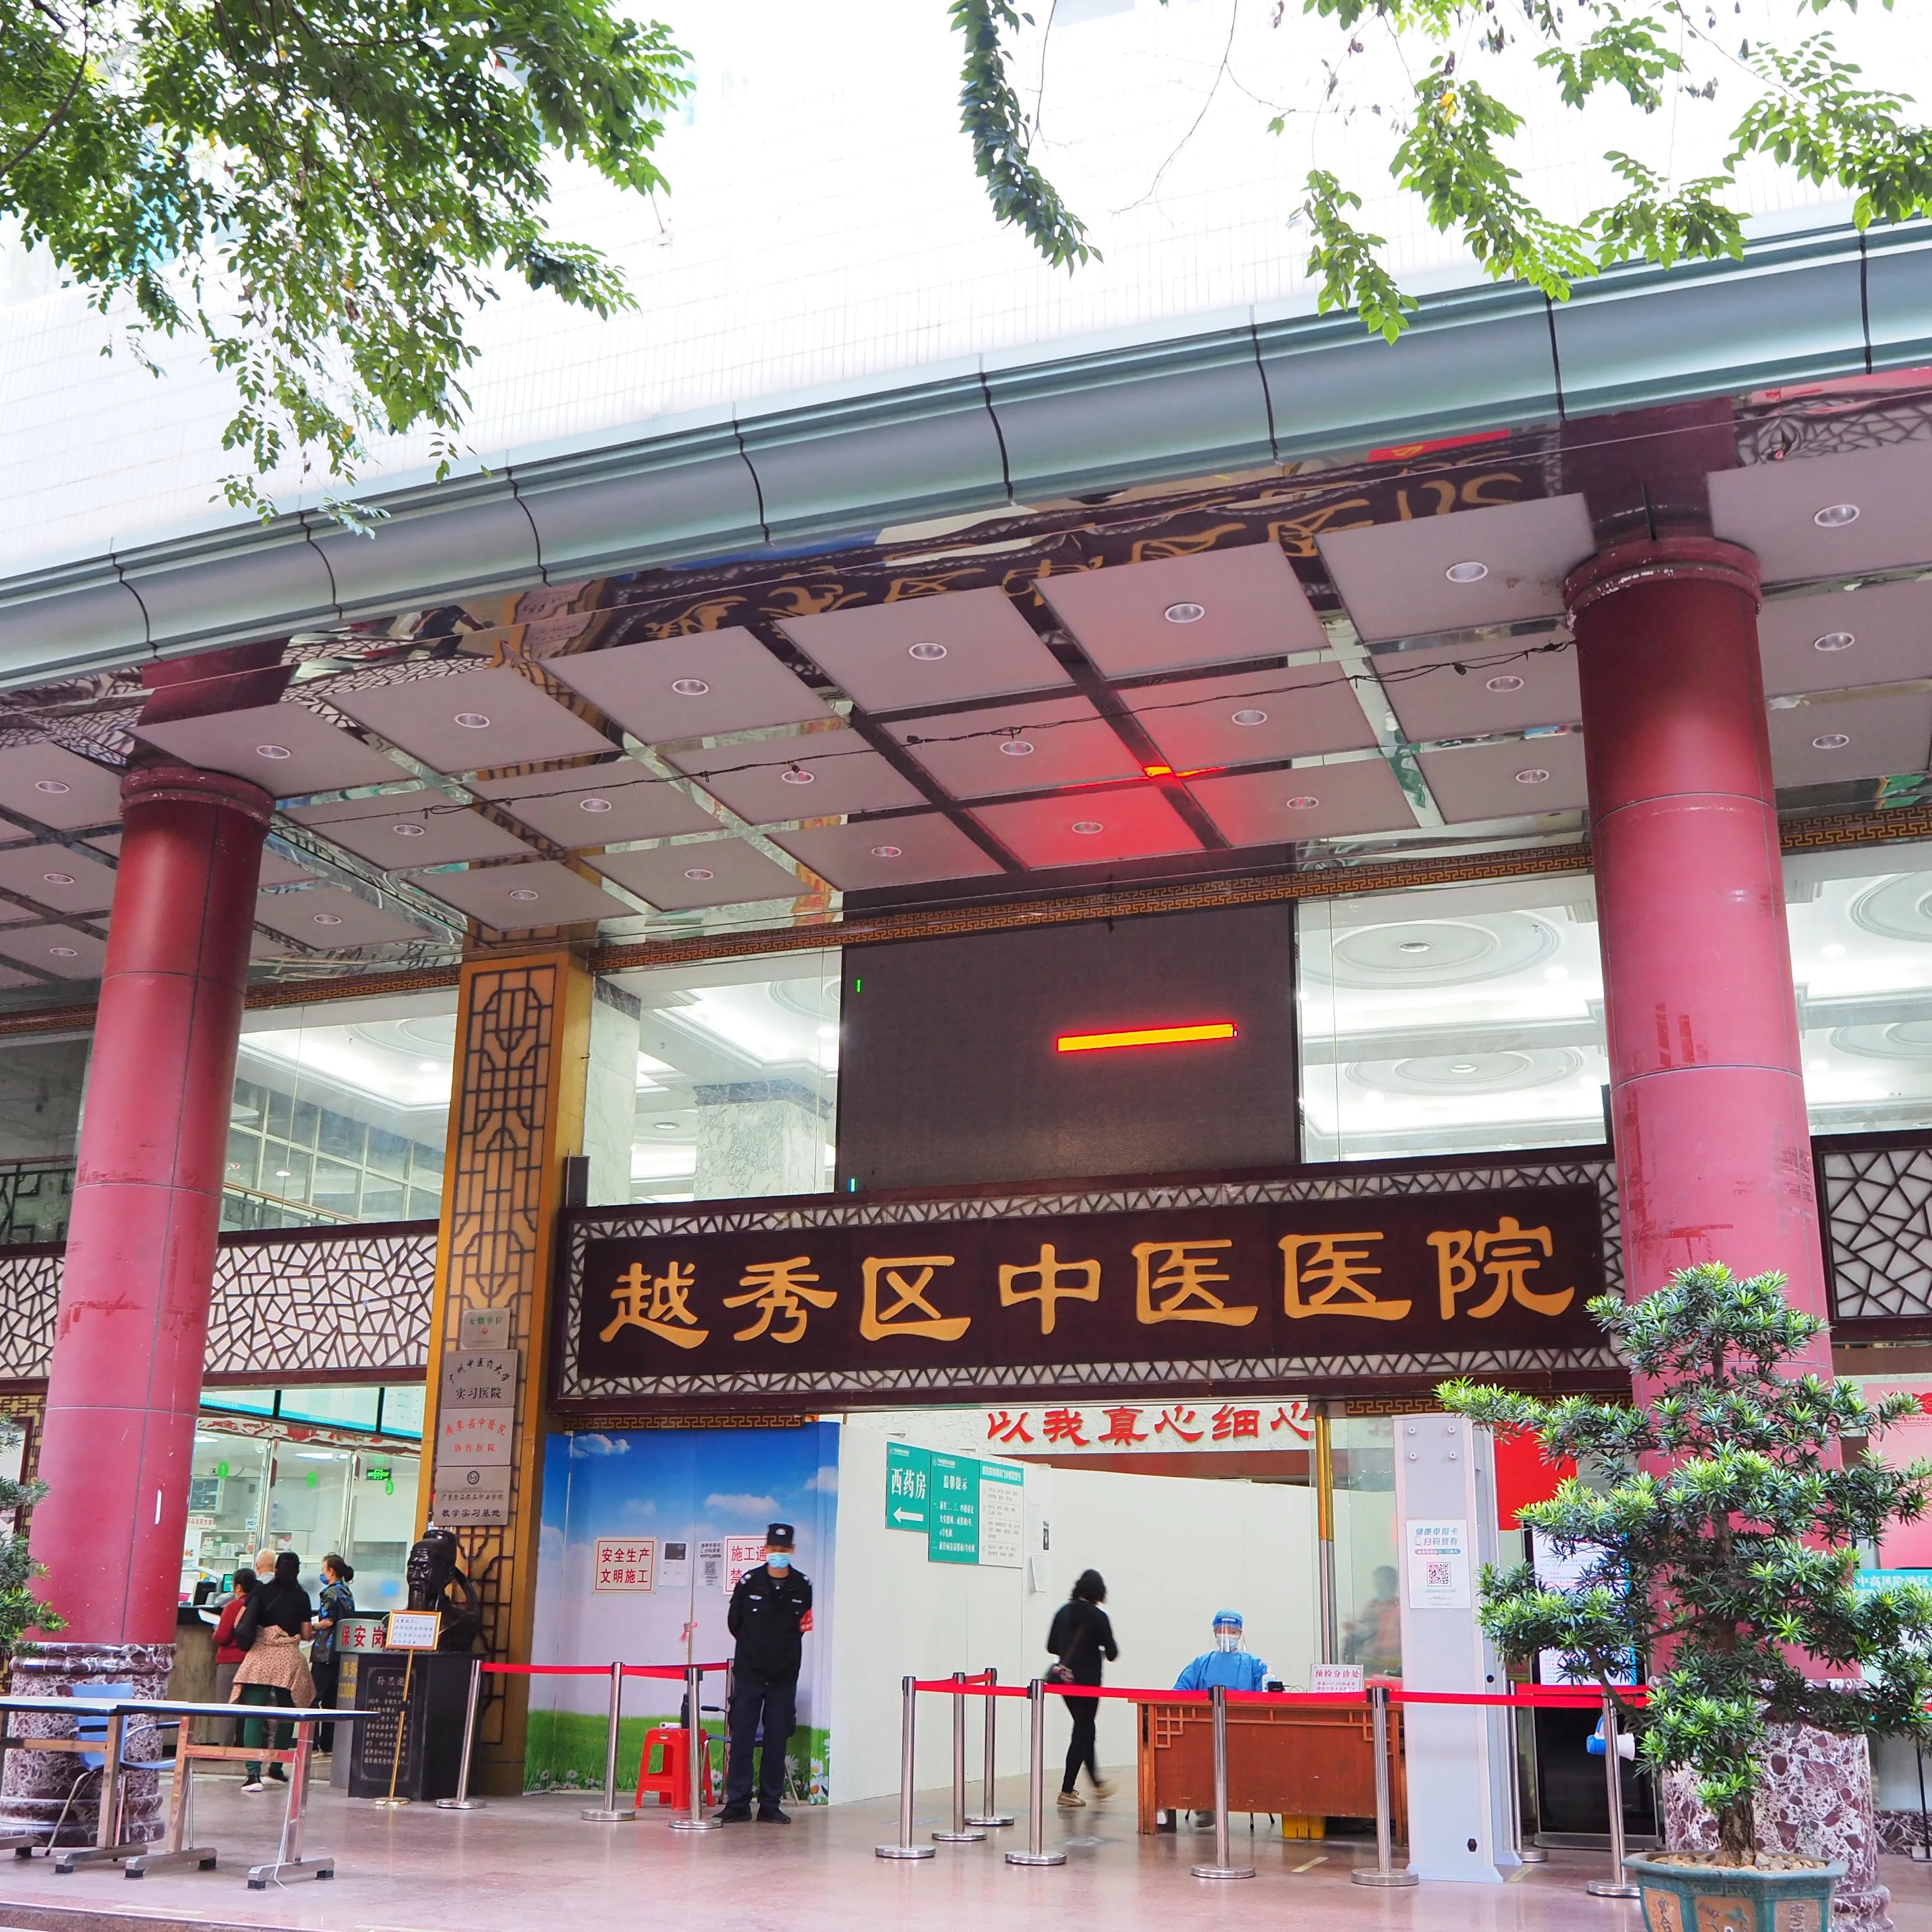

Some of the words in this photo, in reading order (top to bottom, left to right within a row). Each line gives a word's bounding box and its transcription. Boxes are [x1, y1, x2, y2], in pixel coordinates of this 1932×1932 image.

[599, 1216, 1575, 1349] 越秀区中医医院
[456, 1386, 501, 1400] 实习医院
[454, 1443, 495, 1452] 协作医院
[891, 1467, 926, 1499] 西药房
[943, 1475, 968, 1491] 温馨提示
[441, 1509, 501, 1518] 教学实习基地
[602, 1547, 650, 1563] 安全生产
[600, 1569, 648, 1584] 文明施工
[1857, 1575, 1932, 1588] 中高风险地区
[342, 1625, 385, 1648] 保安岗
[1315, 1669, 1360, 1678] 预检分诊处
